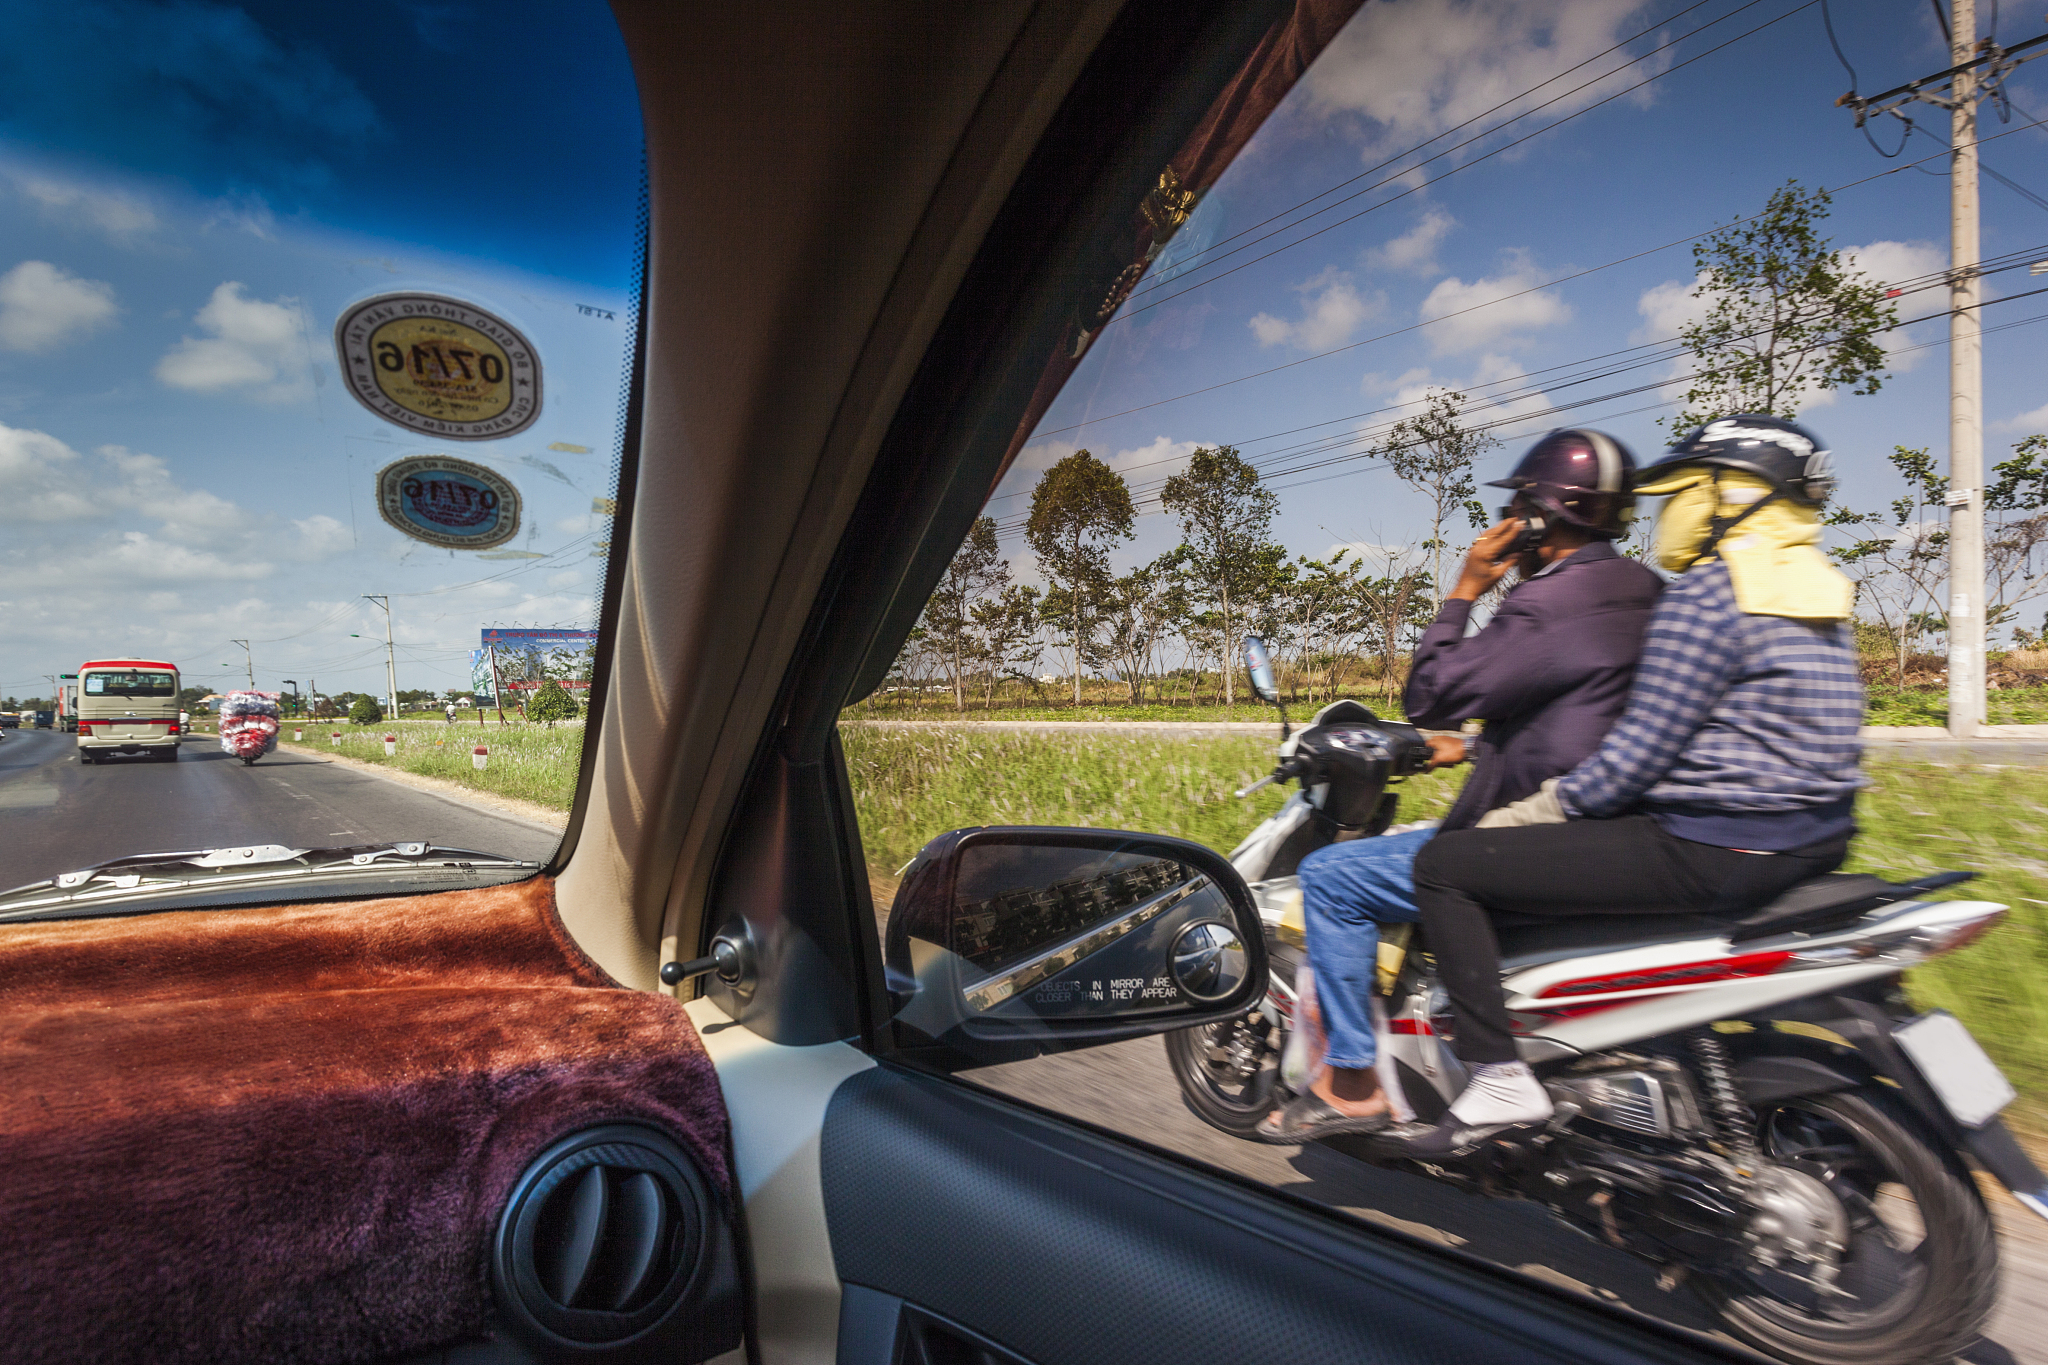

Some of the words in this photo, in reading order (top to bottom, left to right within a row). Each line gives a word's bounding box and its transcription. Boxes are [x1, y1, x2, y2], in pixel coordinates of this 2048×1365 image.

[1040, 981, 1081, 992] OBJECTS
[1092, 980, 1102, 990] IN
[1110, 978, 1144, 989] MIRROR
[1152, 977, 1171, 987] ARE
[1035, 991, 1072, 1003] CLOSER
[1080, 991, 1104, 1001] THAN
[1110, 989, 1134, 999] THEY
[1141, 987, 1177, 998] APPEAR
